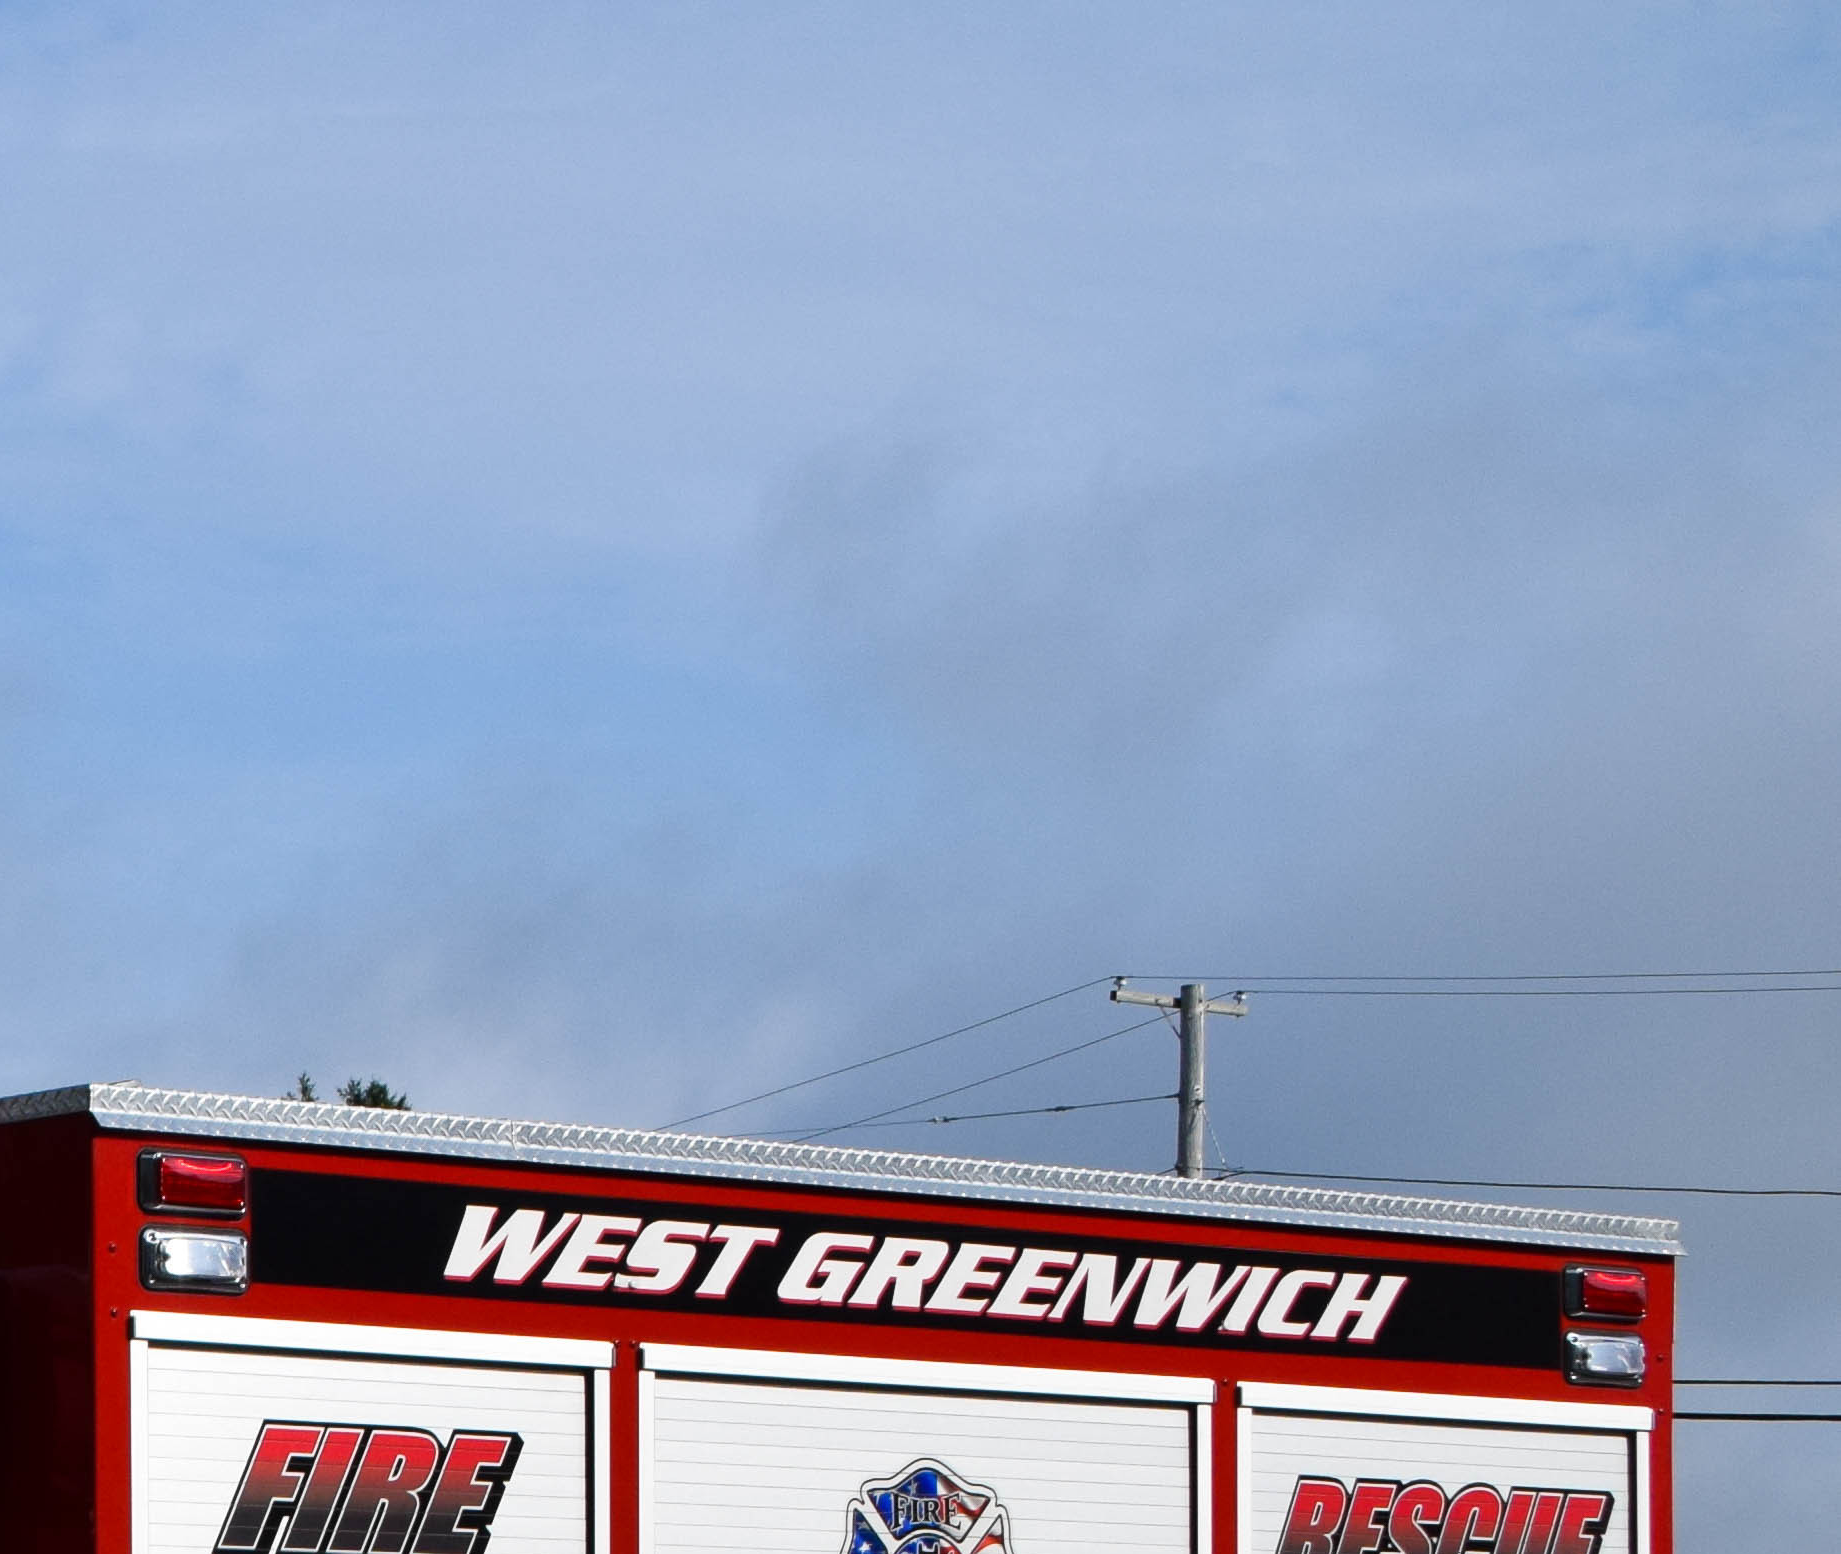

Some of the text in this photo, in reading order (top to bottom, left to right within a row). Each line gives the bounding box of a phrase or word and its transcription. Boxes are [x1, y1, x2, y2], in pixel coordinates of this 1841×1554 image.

[442, 1204, 1410, 1344] WEST GREENWICH
[891, 1491, 962, 1530] FIRE
